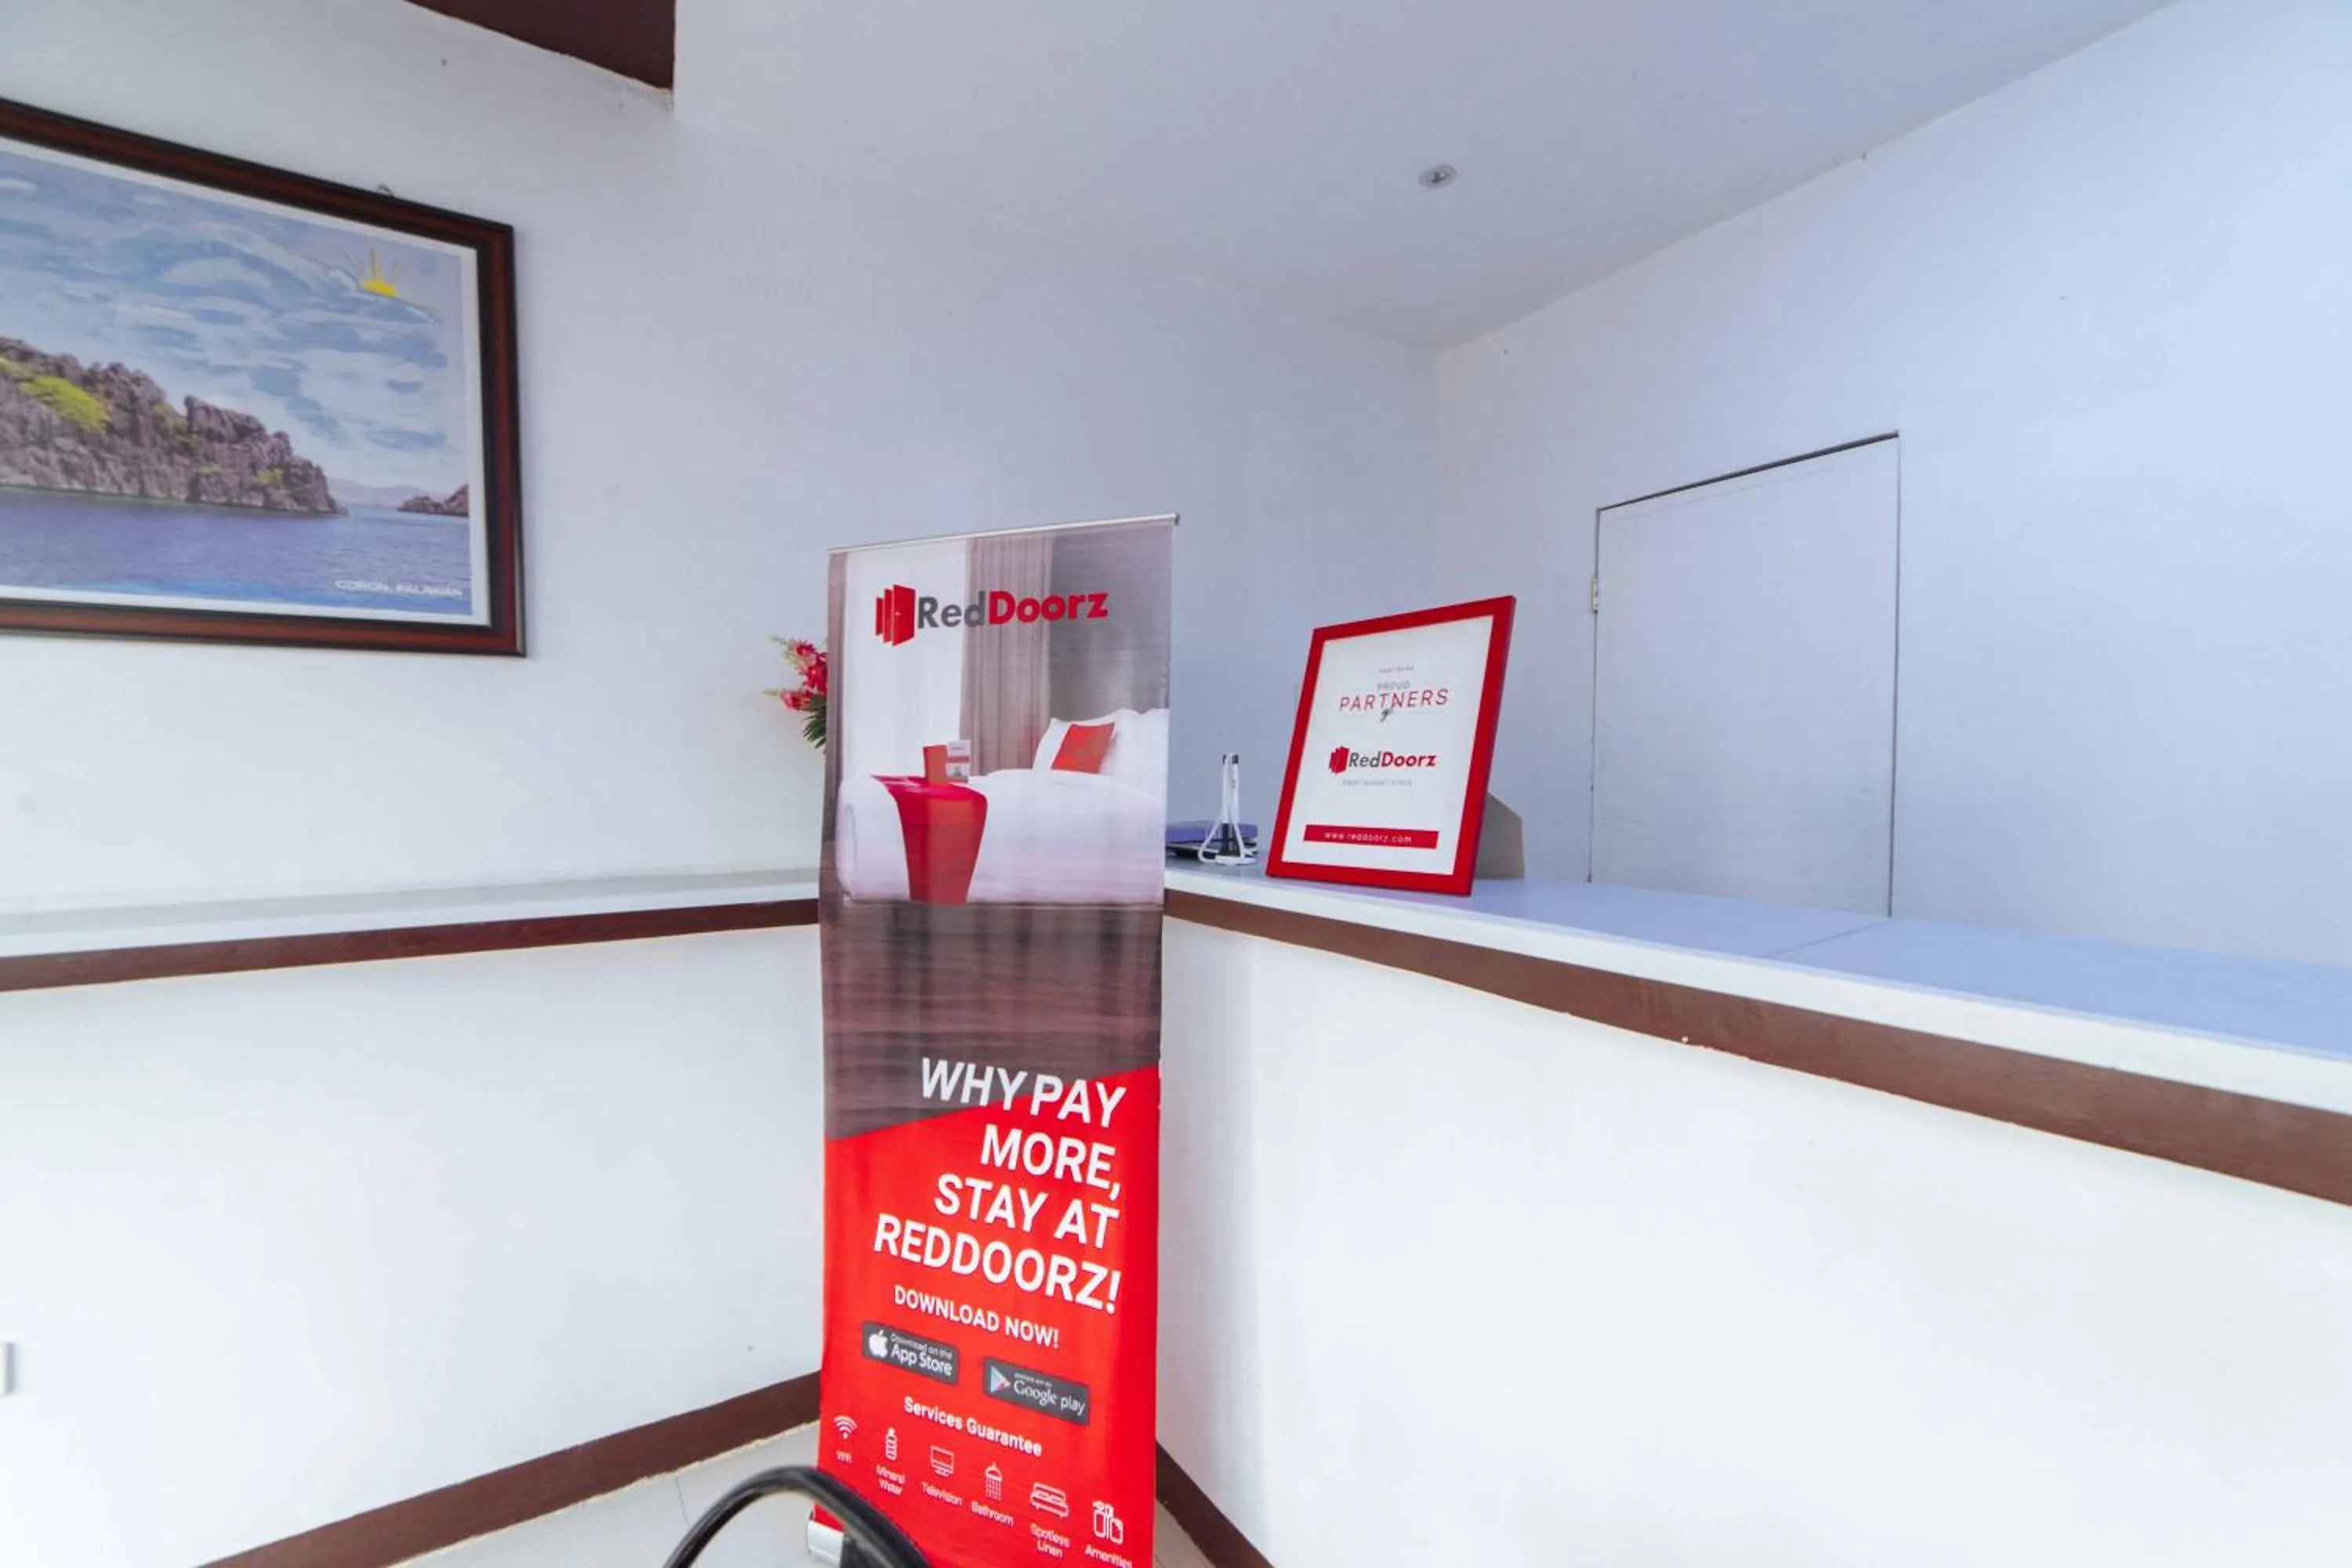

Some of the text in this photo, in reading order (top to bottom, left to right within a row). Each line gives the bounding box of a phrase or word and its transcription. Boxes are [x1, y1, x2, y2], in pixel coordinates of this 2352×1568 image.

[917, 590, 1109, 629] RedDoorz
[1339, 688, 1449, 711] PARTNERS
[1348, 750, 1436, 768] RedDoorz
[921, 1058, 1127, 1127] WHY PAY
[980, 1123, 1121, 1201] MORE,
[934, 1174, 1120, 1249] STAY AT
[873, 1213, 1121, 1314] REDDOORZ!
[894, 1285, 1058, 1348] DOWNLOAD NOW!
[891, 1343, 953, 1376] App Store
[1014, 1380, 1058, 1406] Google
[1061, 1395, 1086, 1416] play
[904, 1396, 1042, 1456] Services Guarantee
[879, 1479, 903, 1496] Water
[921, 1481, 963, 1505] Television
[971, 1501, 1014, 1527] Bathroom
[1029, 1523, 1071, 1548] Spotless
[1036, 1539, 1063, 1559] Linen
